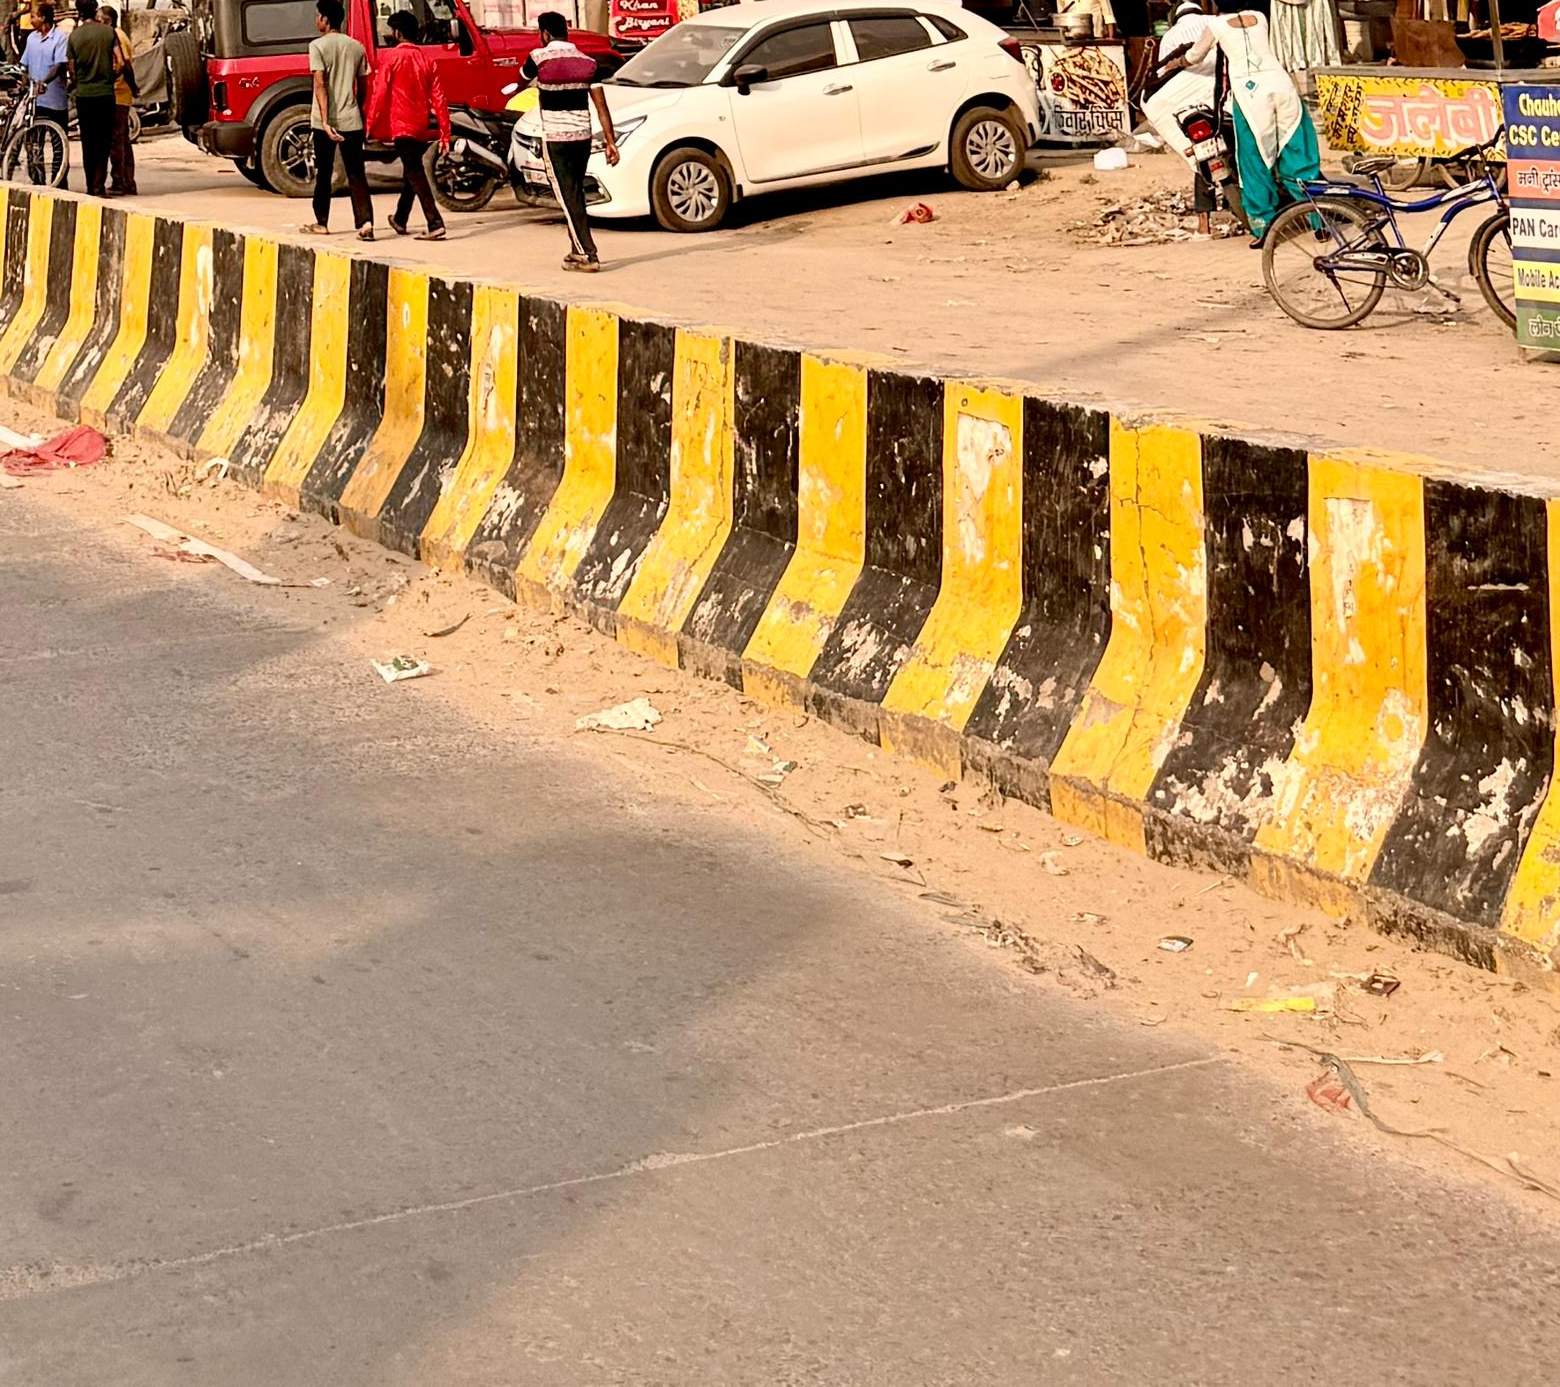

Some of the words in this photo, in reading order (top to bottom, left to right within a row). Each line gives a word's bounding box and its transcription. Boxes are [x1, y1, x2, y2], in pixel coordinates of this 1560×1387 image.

[619, 0, 659, 10] Khan
[614, 16, 670, 32] Biryani
[1363, 84, 1499, 147] जलेबी
[1508, 124, 1538, 146] CSC
[1541, 125, 1560, 147] Ce
[1517, 166, 1539, 187] मनी
[1512, 217, 1536, 237] PAN
[1539, 218, 1560, 238] Car
[1517, 268, 1546, 288] Mobile
